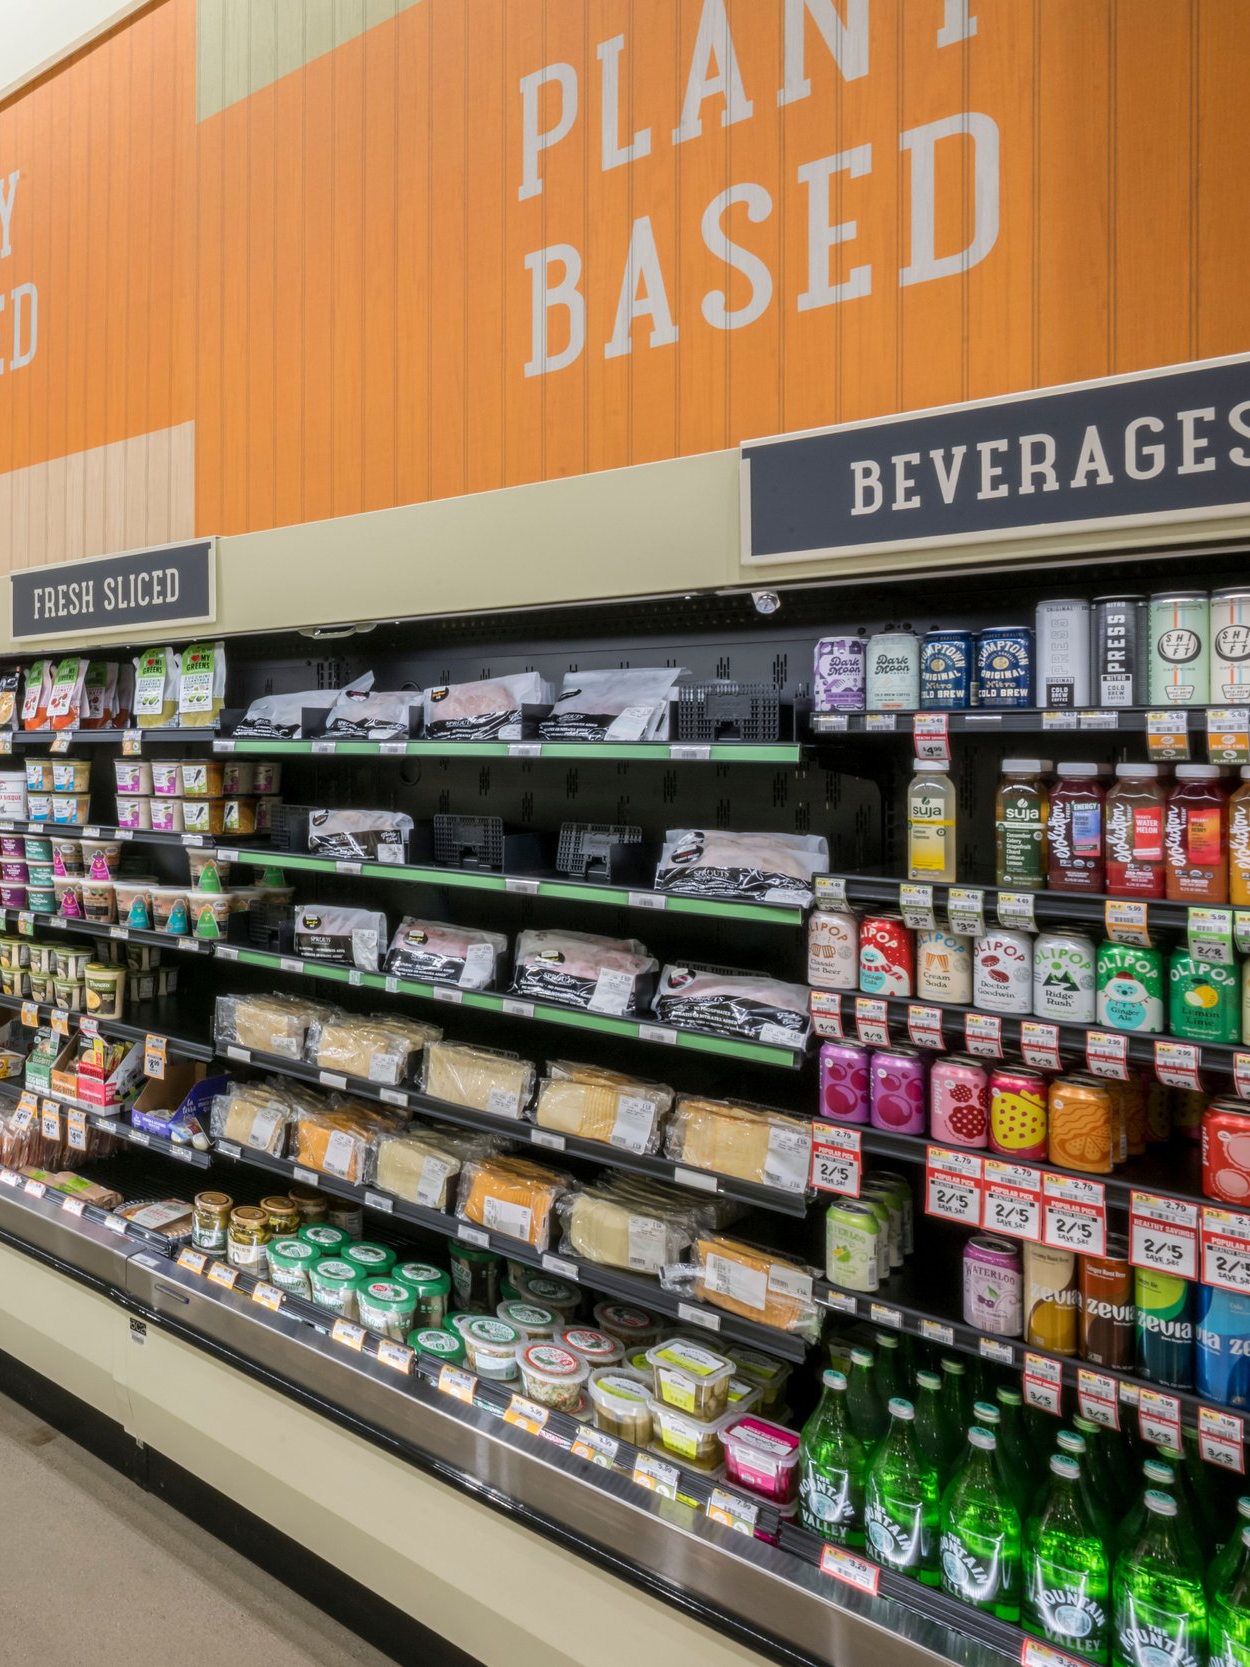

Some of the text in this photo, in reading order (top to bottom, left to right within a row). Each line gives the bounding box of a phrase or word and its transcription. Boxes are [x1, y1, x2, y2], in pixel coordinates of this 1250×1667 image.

[518, 0, 978, 201] PLAN
[524, 111, 1000, 378] BASED
[34, 568, 179, 619] FRESH SLICED
[1107, 614, 1126, 673] PRESS
[876, 654, 909, 666] Dark
[978, 641, 1030, 668] STUMPTOWN
[186, 662, 210, 672] GREENS
[829, 657, 860, 667] Dark
[142, 665, 163, 675] GREENS
[828, 666, 861, 677] Moon
[874, 665, 910, 675] Moon
[980, 668, 1026, 679] ORIGINAL
[937, 689, 965, 698] BREW
[978, 688, 1029, 698] COLD BREW
[913, 806, 942, 818] suja
[1074, 803, 1097, 811] ENERGY
[1006, 808, 1039, 821] suja
[1136, 819, 1159, 827] WATER
[1136, 826, 1158, 834] MELON
[693, 869, 731, 877] SPROUTS
[810, 959, 836, 968] Classic
[1034, 949, 1092, 971] OLIPOP
[823, 967, 842, 976] Beer
[1097, 955, 1159, 979] OLIPOP
[924, 971, 951, 980] Cream
[1170, 962, 1236, 987] OLIPOP
[925, 979, 948, 989] Soda
[980, 980, 1011, 991] Doctor
[977, 987, 1016, 999] Goodwin
[1045, 990, 1074, 1000] Ridge
[1110, 1006, 1140, 1017] Ginger
[1118, 1014, 1133, 1022] Ale
[1182, 1006, 1220, 1019] Lemon
[1186, 1016, 1215, 1027] Lime
[818, 1147, 855, 1161] POPULAR PICK
[820, 1163, 849, 1181] 2/$5
[934, 1172, 975, 1188] POPULAR PICK
[937, 1189, 969, 1209] 2/$5
[991, 1185, 1034, 1201] POPULAR PICK
[995, 1203, 1030, 1223] 2/$5
[1051, 1200, 1097, 1217] POPULAR PICK
[1056, 1218, 1092, 1238] 2/$5
[1133, 1218, 1196, 1240] HEALTHY SAVINGS
[1144, 1238, 1184, 1260] 2/$5
[1211, 1237, 1245, 1250] POPULAR
[964, 1262, 1016, 1286] WATERLOO
[1137, 1310, 1193, 1339] zevia
[816, 1472, 831, 1484] THE
[798, 1477, 855, 1519] MOUNTAIN
[802, 1508, 848, 1537] VALLEY
[948, 1531, 962, 1546] THE
[1035, 1588, 1106, 1628] MOUNTAIN
[1148, 1624, 1169, 1636] THE
[1043, 1625, 1100, 1652] VALLEY
